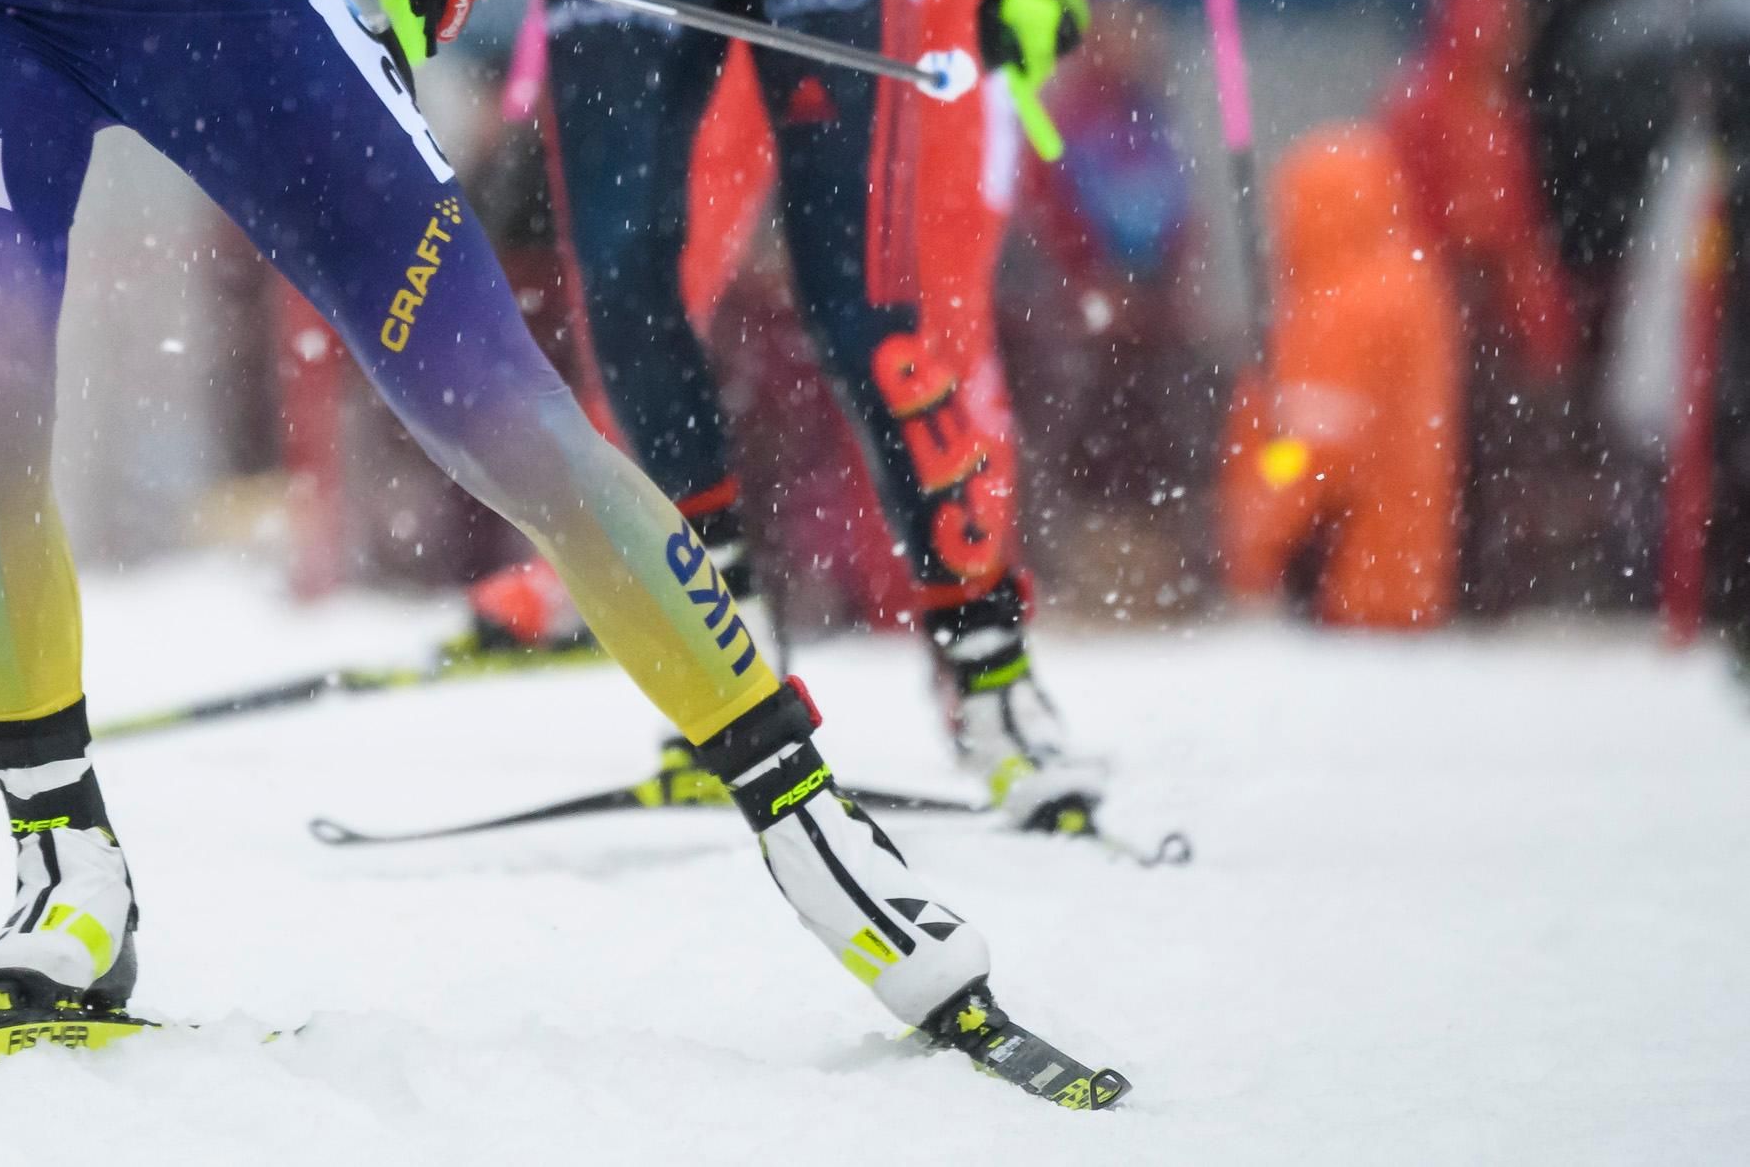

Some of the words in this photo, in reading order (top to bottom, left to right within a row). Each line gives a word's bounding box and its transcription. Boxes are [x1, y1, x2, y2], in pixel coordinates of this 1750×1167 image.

[380, 216, 452, 353] CRAFT
[666, 520, 756, 677] UKR
[10, 815, 70, 833] CHER
[771, 763, 831, 815] FISCH
